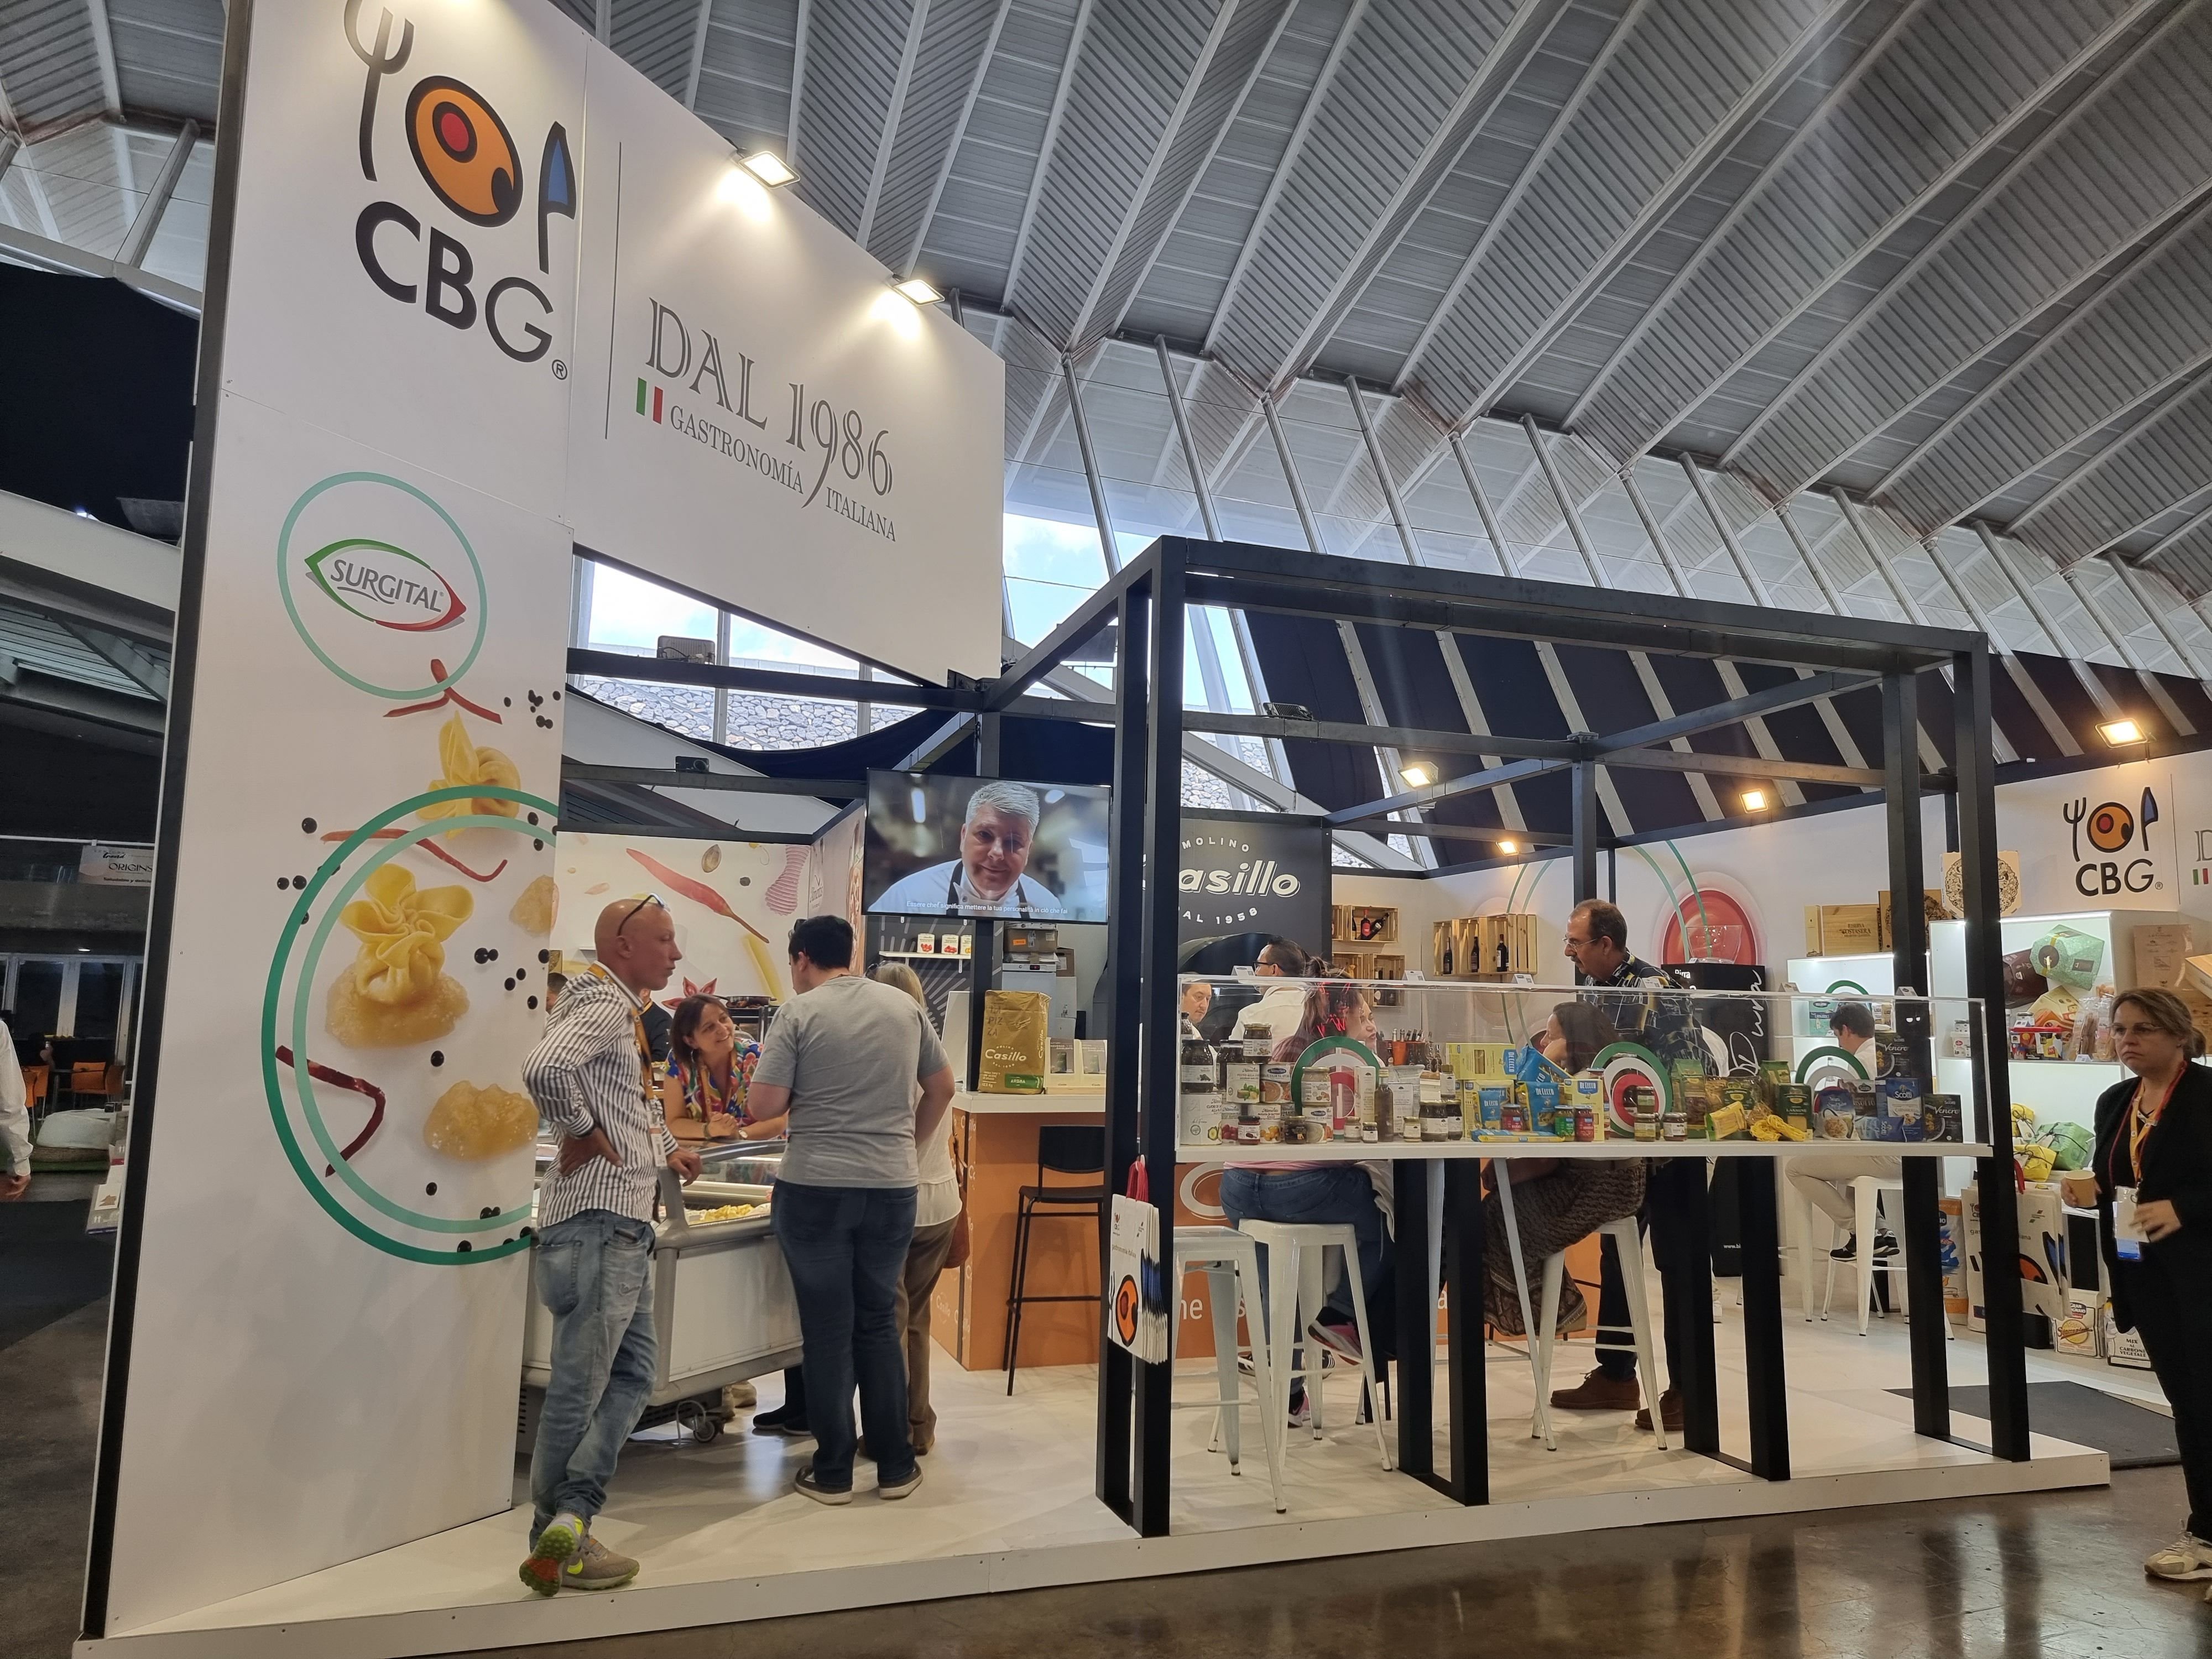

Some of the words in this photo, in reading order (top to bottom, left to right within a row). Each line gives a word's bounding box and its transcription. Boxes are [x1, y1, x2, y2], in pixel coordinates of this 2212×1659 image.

[356, 201, 554, 363] CBG
[645, 297, 768, 430] DAL
[785, 382, 893, 509] 1986
[670, 405, 804, 494] GASTRONOMÍA
[825, 486, 896, 542] ITALIANA
[331, 559, 442, 613] SURGITAL
[1182, 836, 1250, 853] MOLINO
[1178, 860, 1301, 898] asillo
[2075, 858, 2154, 897] CBG
[1178, 906, 1204, 923] AL
[1216, 907, 1258, 925] 1958
[985, 1048, 1027, 1062] Casillo
